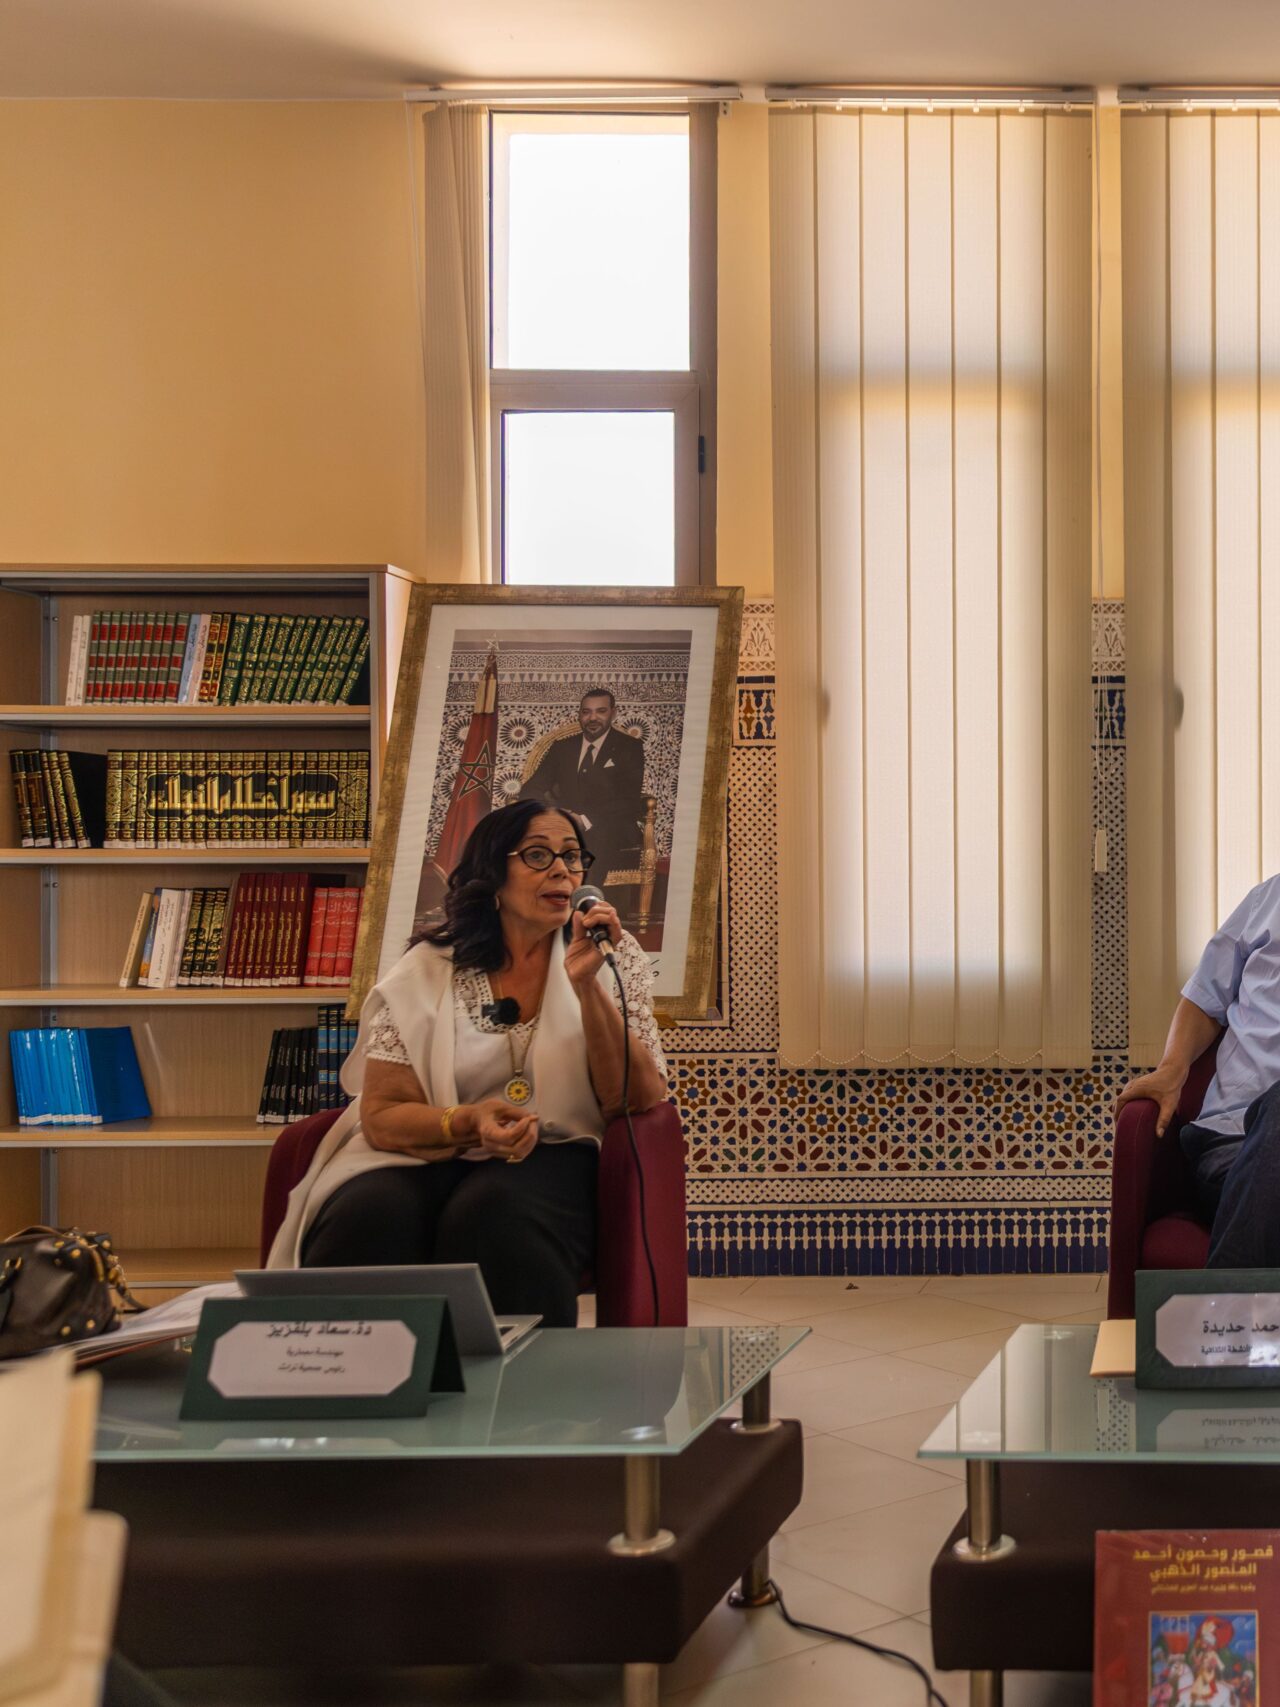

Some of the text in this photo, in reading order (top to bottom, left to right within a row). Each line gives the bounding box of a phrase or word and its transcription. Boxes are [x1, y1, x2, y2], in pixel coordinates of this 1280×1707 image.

[1203, 1321, 1245, 1337] حديدة
[1133, 1543, 1274, 1563] قصور وحصون أحمد
[1150, 1562, 1257, 1582] المنصور الذهبي
